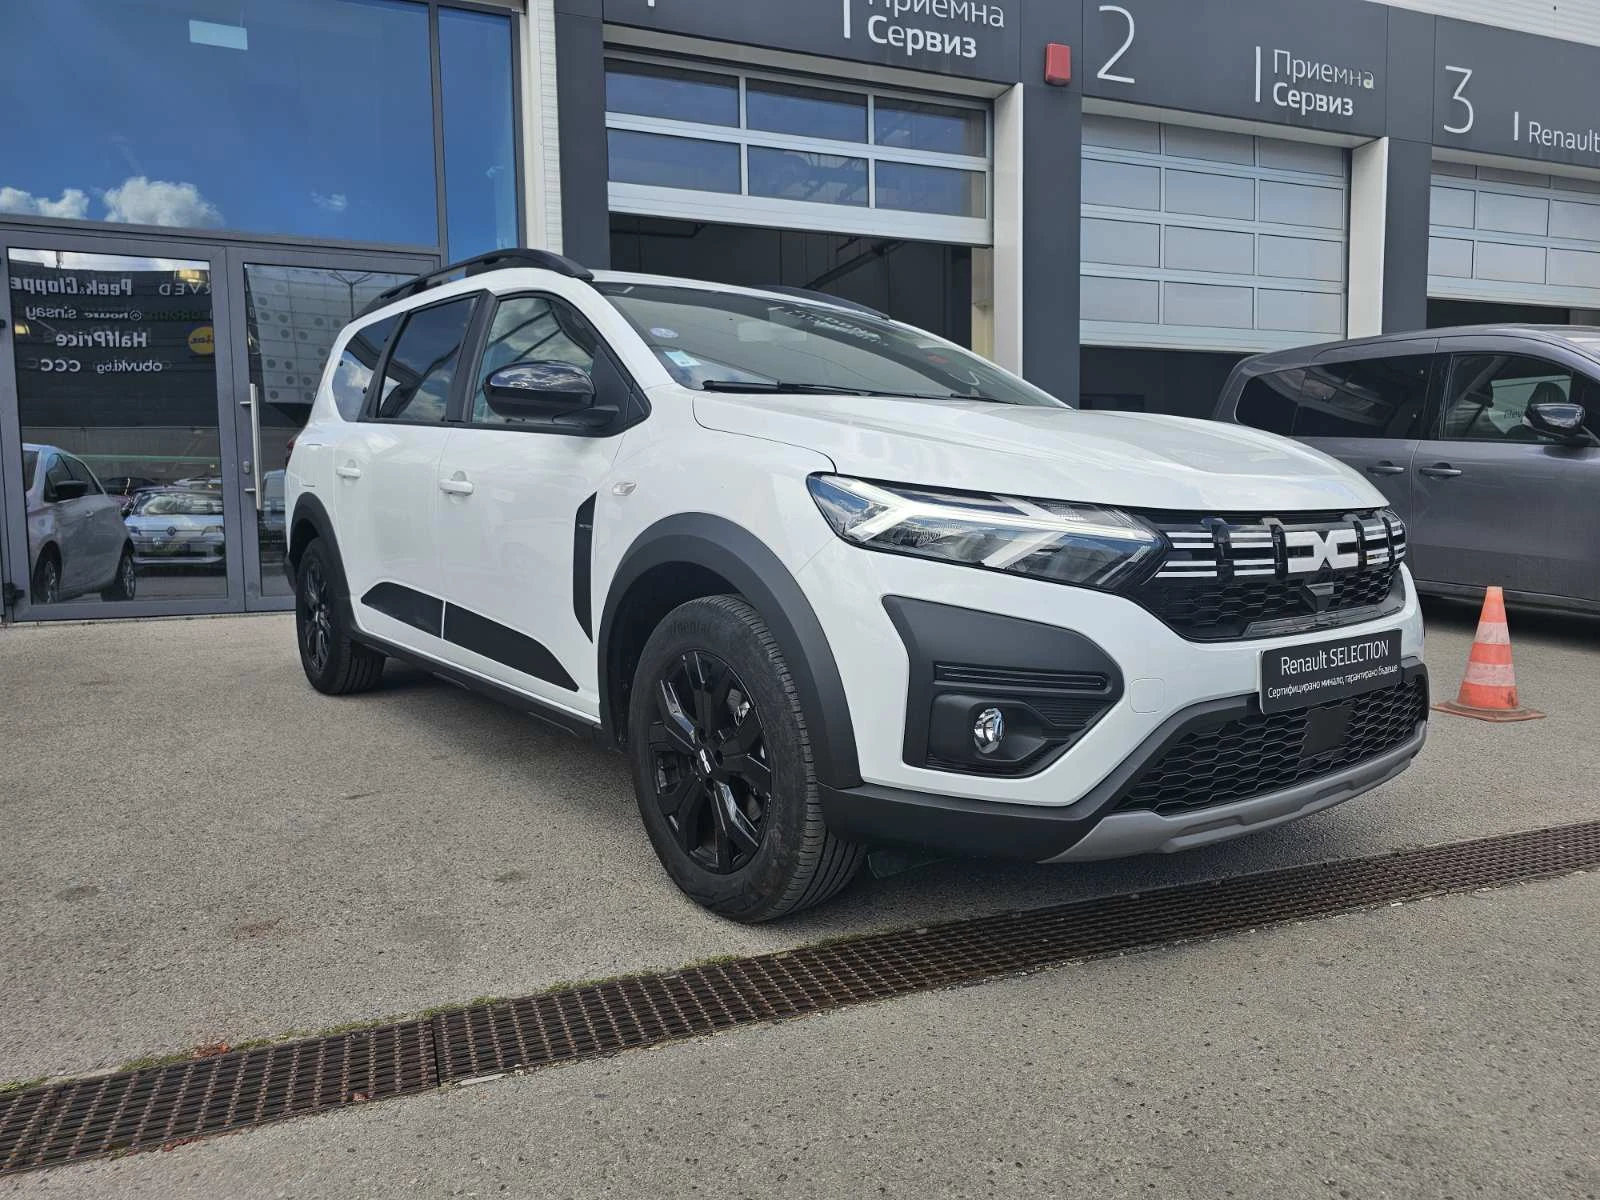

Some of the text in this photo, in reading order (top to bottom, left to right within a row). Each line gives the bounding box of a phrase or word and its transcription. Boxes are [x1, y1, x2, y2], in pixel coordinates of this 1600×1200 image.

[867, 14, 977, 59] Сервиз
[1096, 5, 1136, 84] 2
[1272, 48, 1375, 91] Приемна
[1272, 81, 1354, 117] Сервиз
[1443, 65, 1474, 134] 3
[1529, 121, 1600, 153] Renault
[1281, 640, 1389, 676] Renault SELECTION
